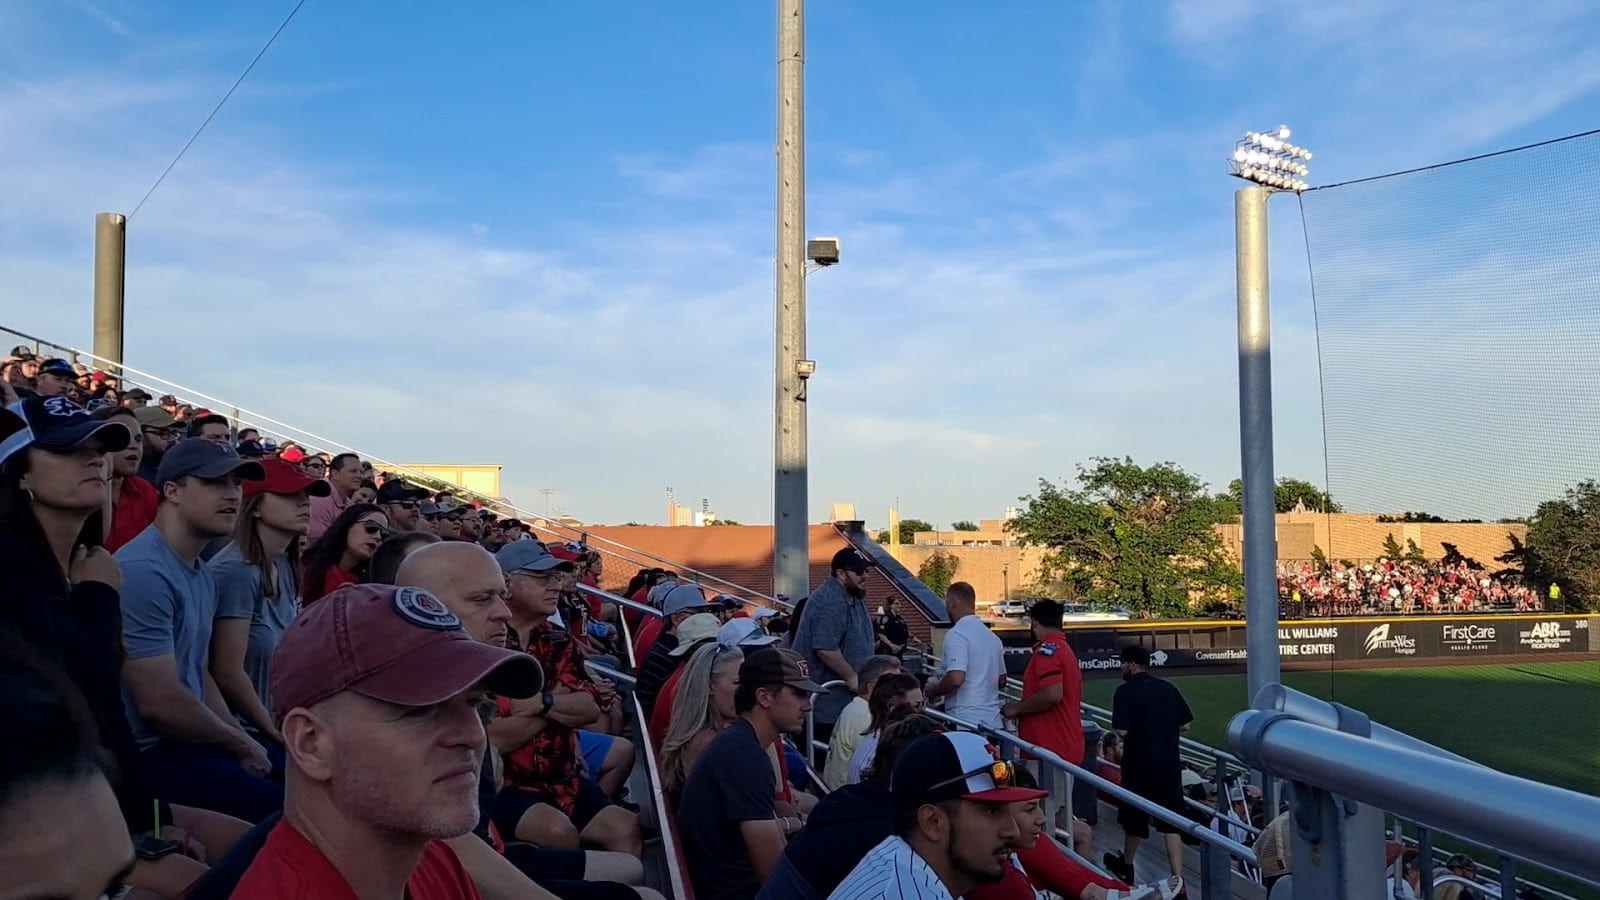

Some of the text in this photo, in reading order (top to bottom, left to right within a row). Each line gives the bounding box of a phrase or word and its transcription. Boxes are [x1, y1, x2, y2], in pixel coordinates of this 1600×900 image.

[1278, 627, 1339, 639] ILL WILLIAMS
[1443, 624, 1496, 640] FirstCare
[1530, 622, 1560, 638] ABR
[1279, 643, 1336, 656] TIRE CENTER
[1078, 657, 1122, 670] insCapita
